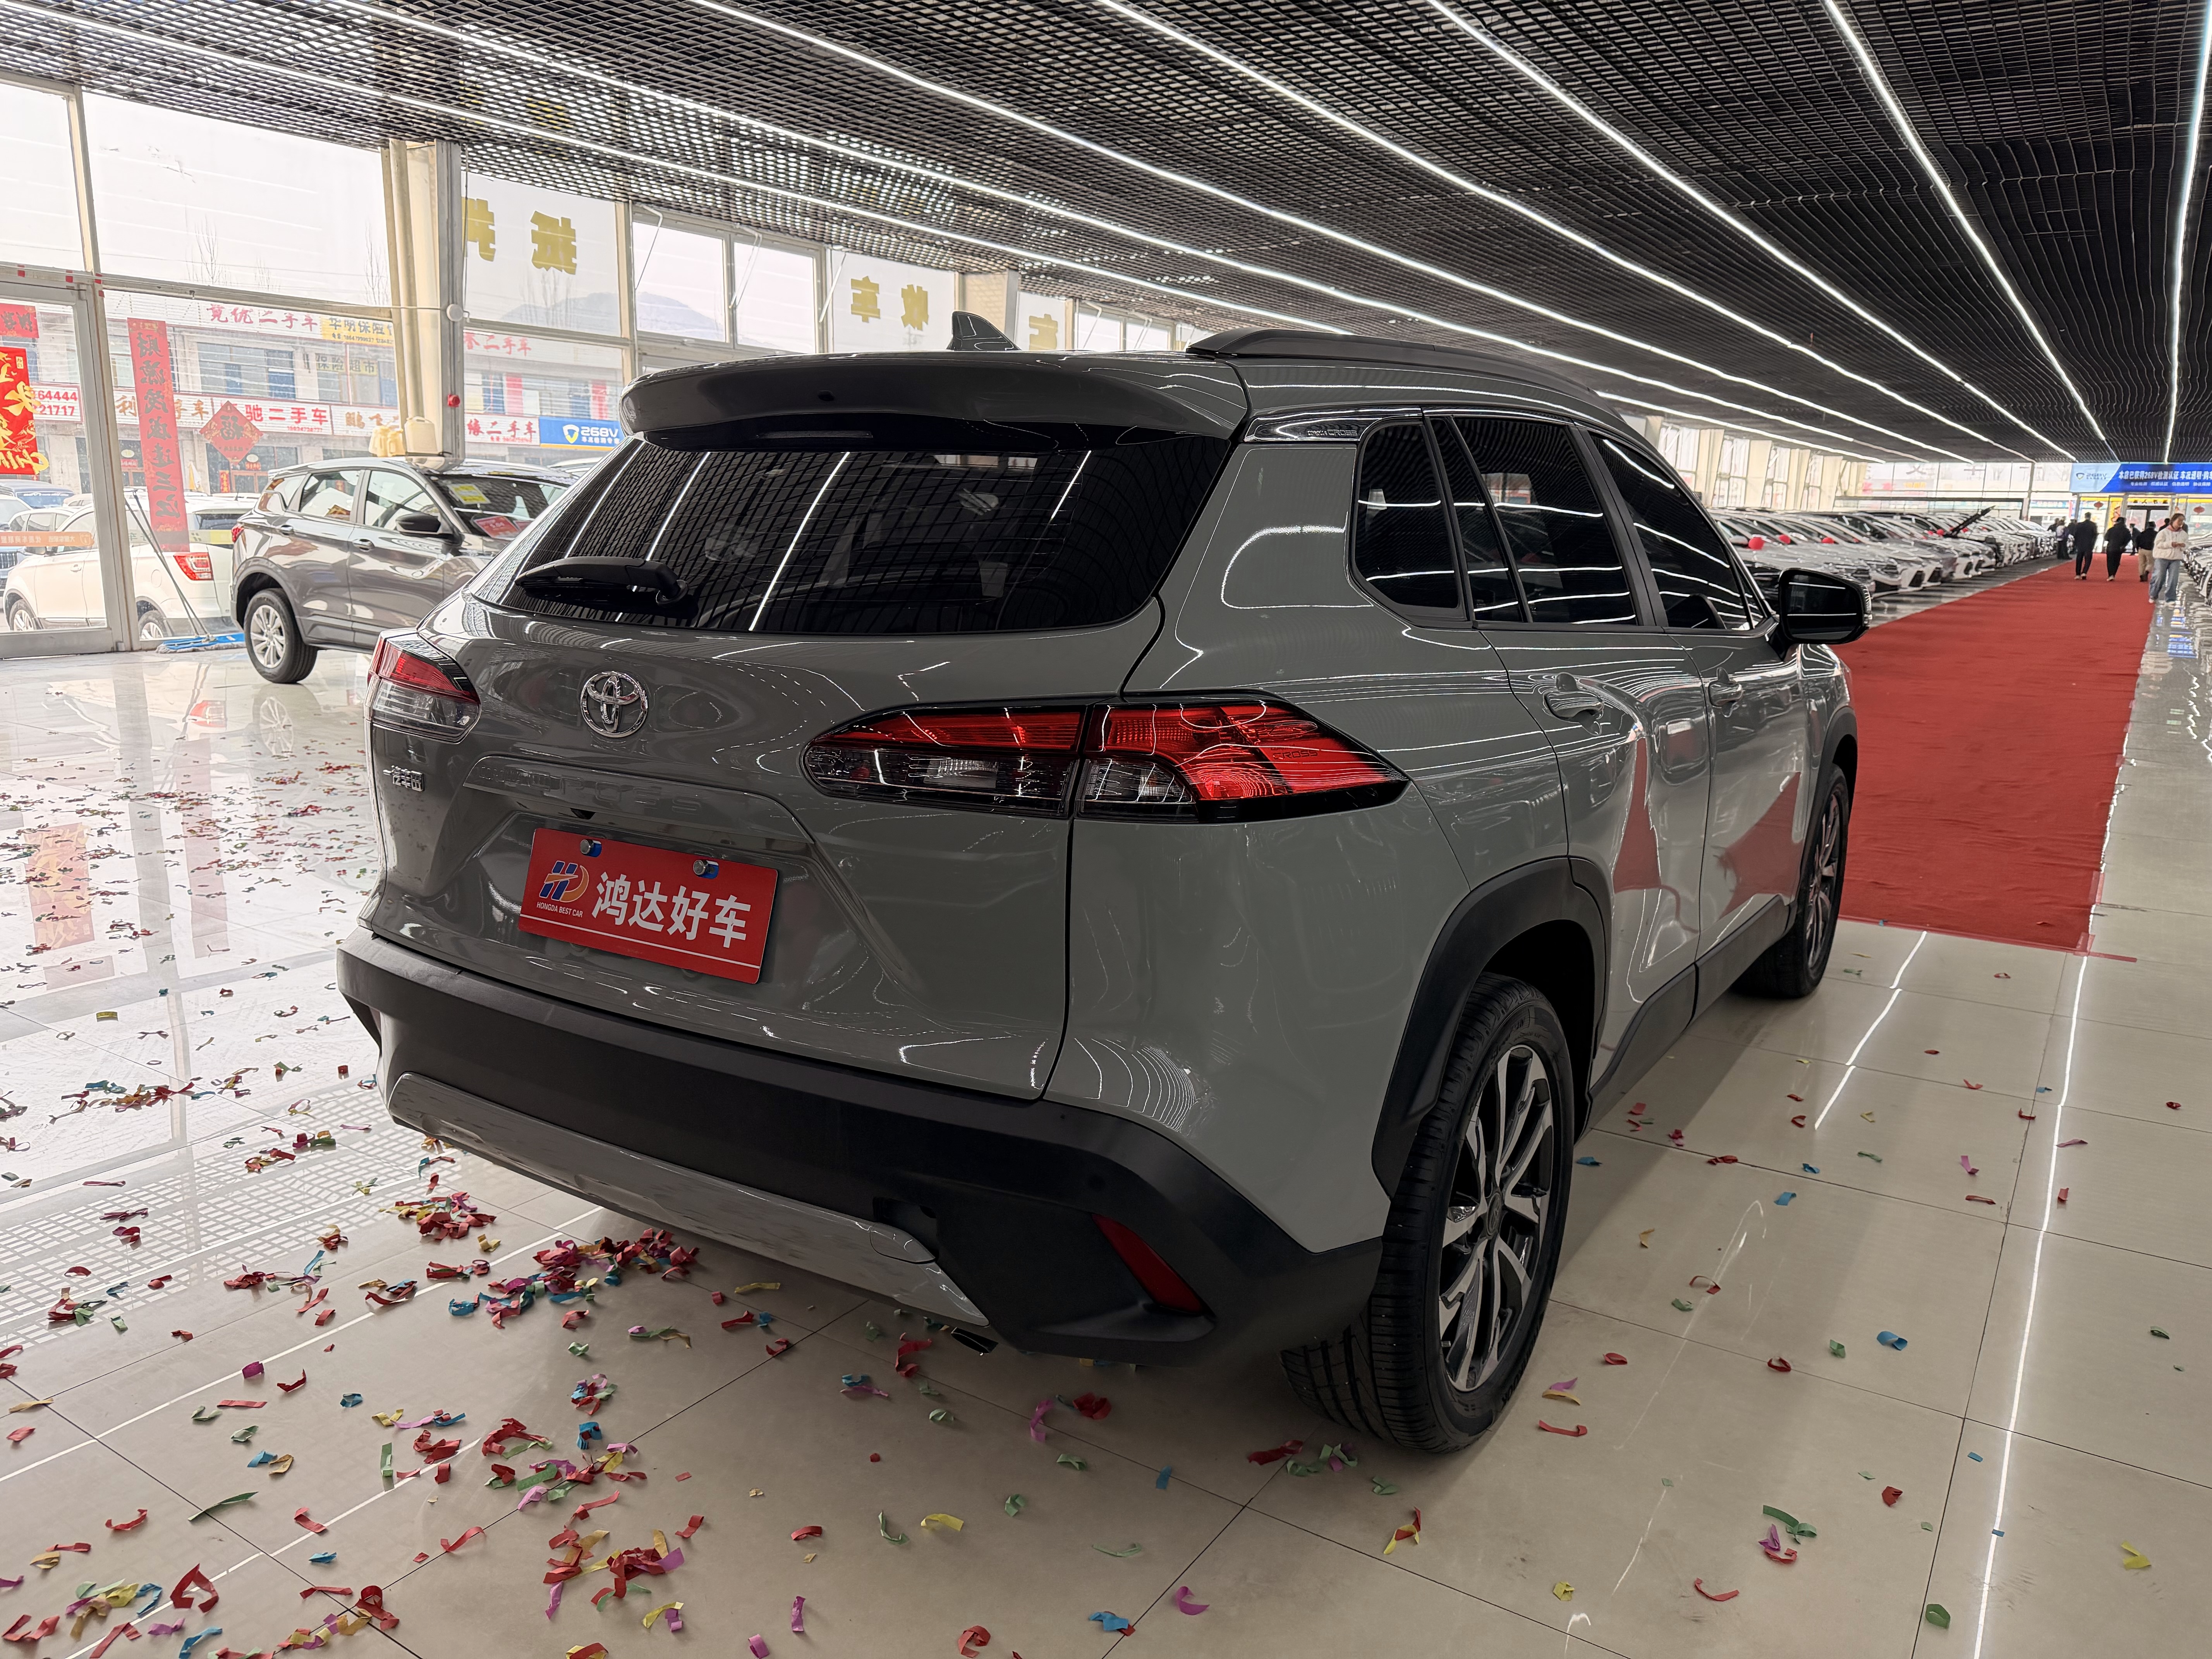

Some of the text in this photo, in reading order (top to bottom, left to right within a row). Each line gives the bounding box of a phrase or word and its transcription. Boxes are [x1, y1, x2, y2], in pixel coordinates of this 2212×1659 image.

[220, 404, 329, 425] 驰二手车
[580, 426, 618, 438] 268V
[1273, 750, 1318, 760] CROSS
[537, 902, 583, 918] HONGDA BEST CAR
[592, 871, 752, 948] 鸿达好车
